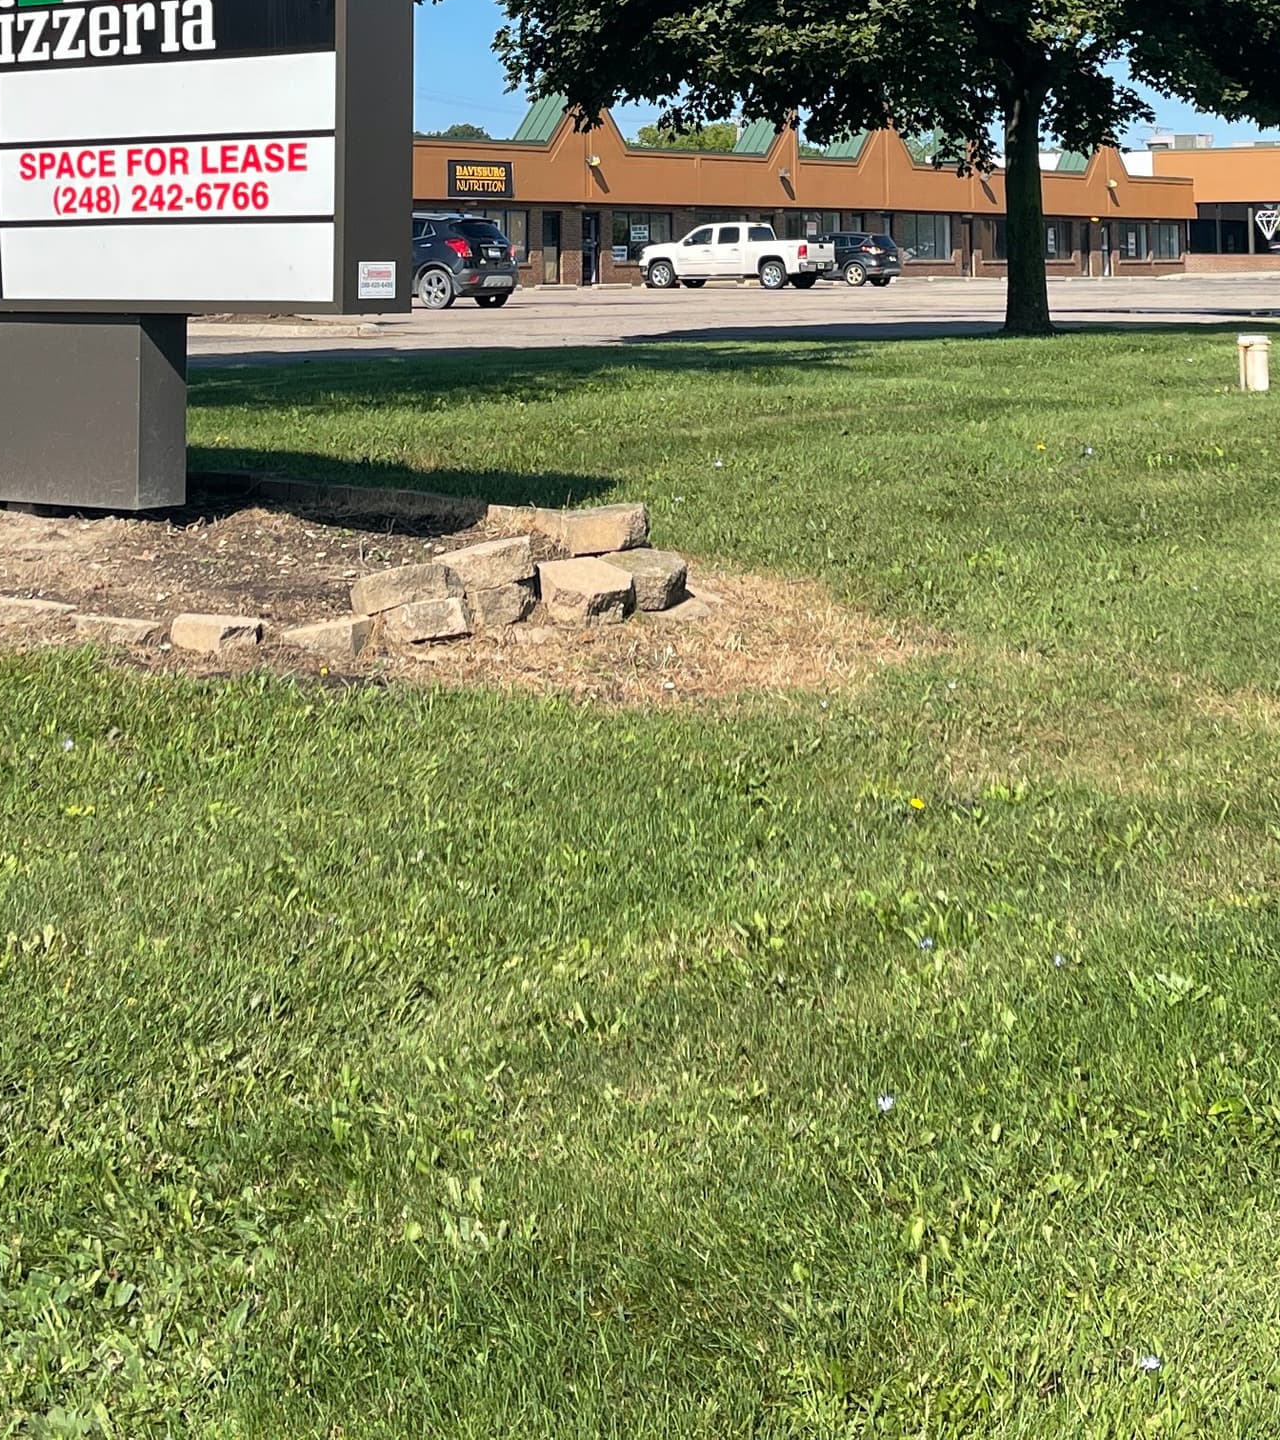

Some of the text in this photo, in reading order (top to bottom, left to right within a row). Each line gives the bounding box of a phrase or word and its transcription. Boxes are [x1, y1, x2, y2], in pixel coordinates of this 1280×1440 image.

[20, 142, 308, 181] SPACE FOR LEASE
[455, 165, 506, 177] DAVISBURG
[456, 179, 506, 192] NUTRITION
[53, 181, 269, 215] (248) 242-6766
